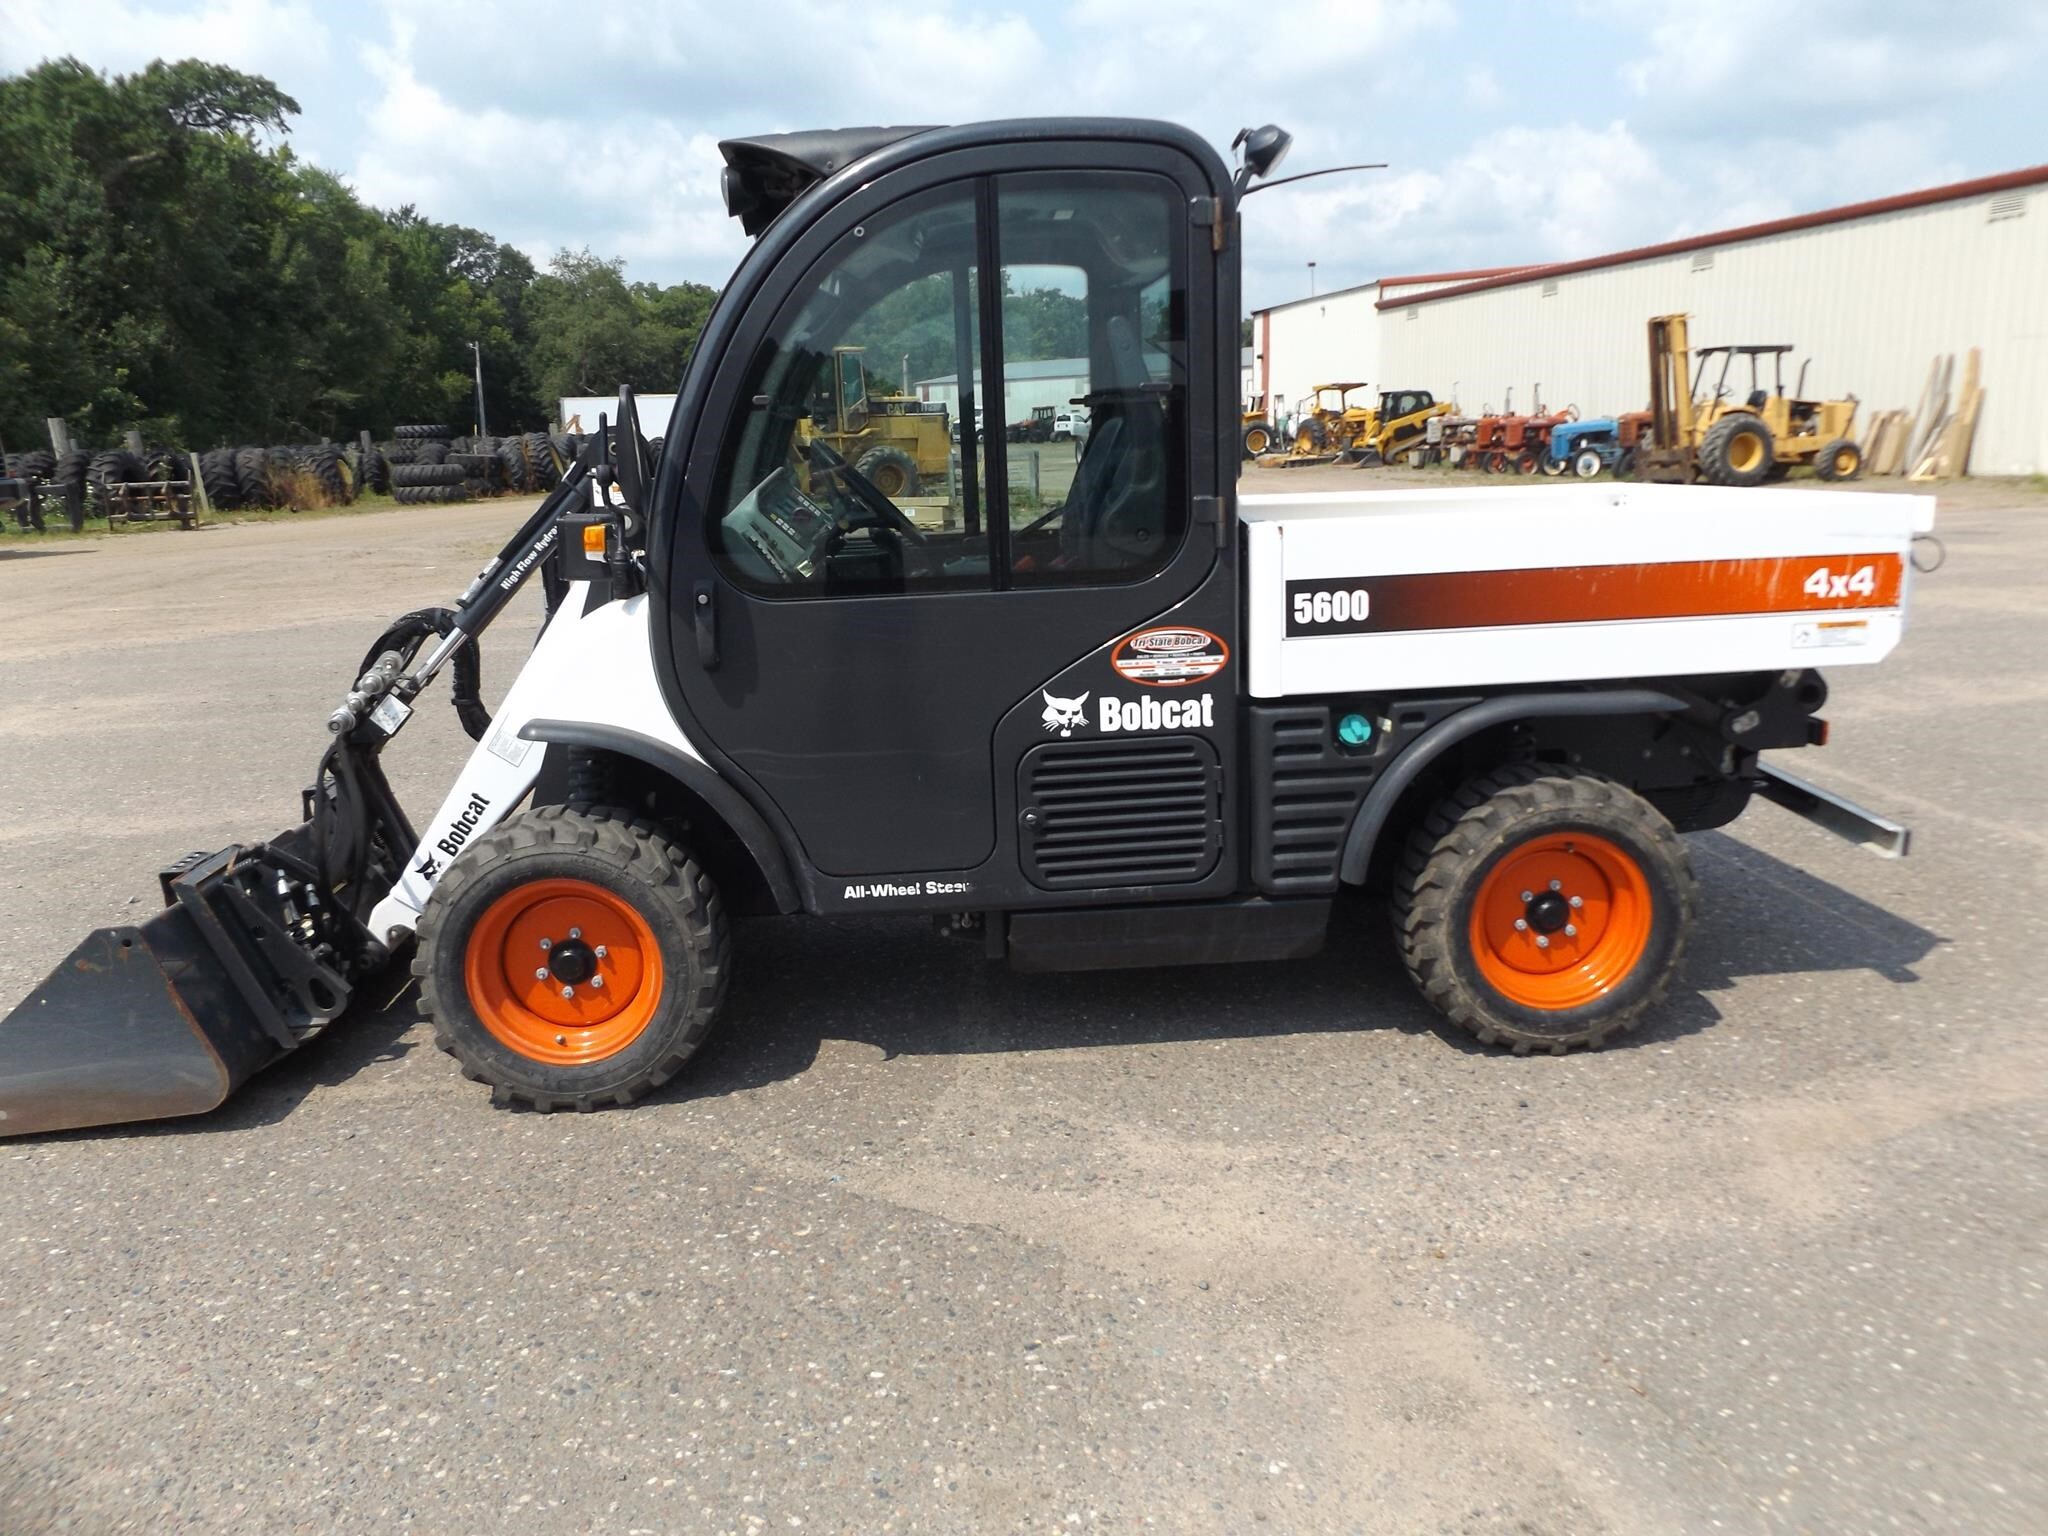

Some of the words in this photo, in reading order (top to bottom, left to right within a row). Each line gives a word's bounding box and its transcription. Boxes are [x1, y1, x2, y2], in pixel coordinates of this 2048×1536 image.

[500, 566, 521, 590] High
[516, 551, 538, 572] Flow
[1803, 565, 1875, 599] 4x4
[1294, 589, 1370, 625] 5600
[1174, 636, 1207, 646] Bobcat
[1099, 693, 1214, 732] Bobcat
[437, 792, 491, 857] Bobcat
[844, 882, 921, 899] All-Wheel
